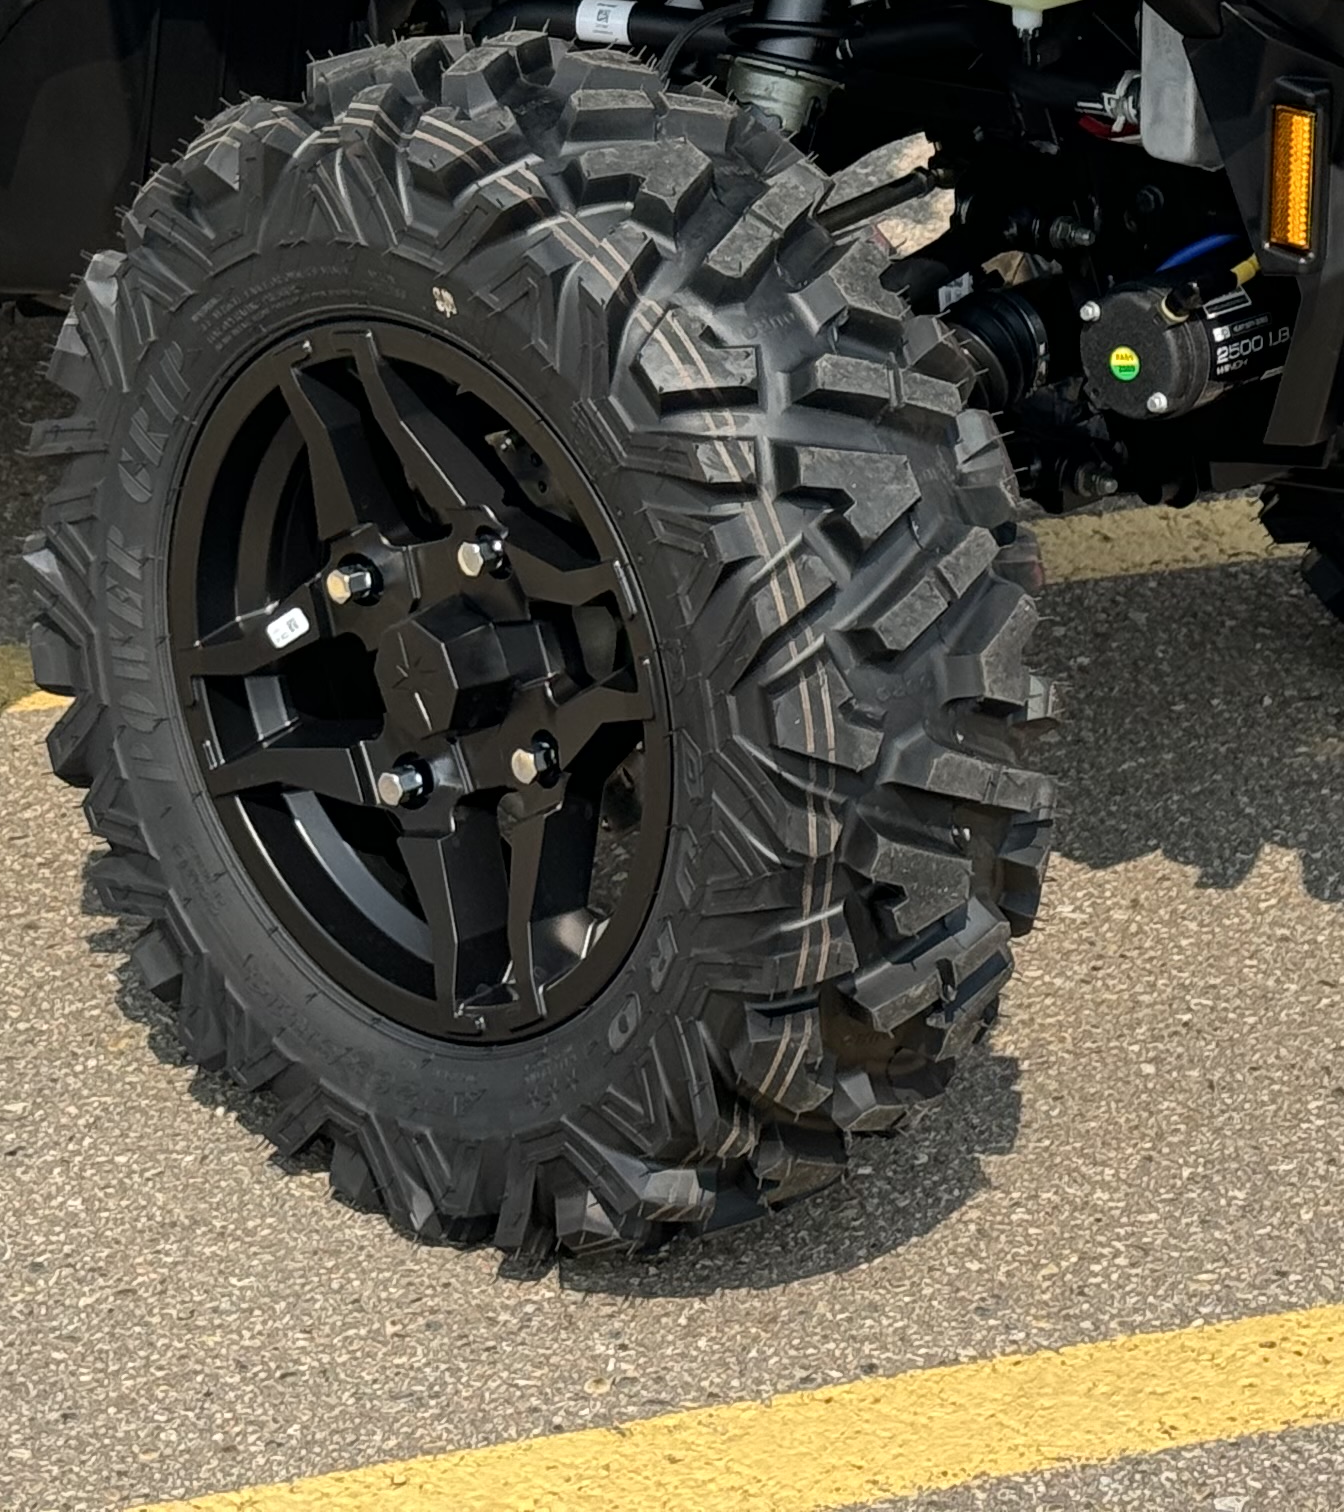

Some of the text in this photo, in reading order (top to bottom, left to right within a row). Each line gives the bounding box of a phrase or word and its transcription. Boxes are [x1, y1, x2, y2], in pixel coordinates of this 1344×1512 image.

[1216, 334, 1264, 365] 2500
[105, 340, 191, 782] POWER GRIP
